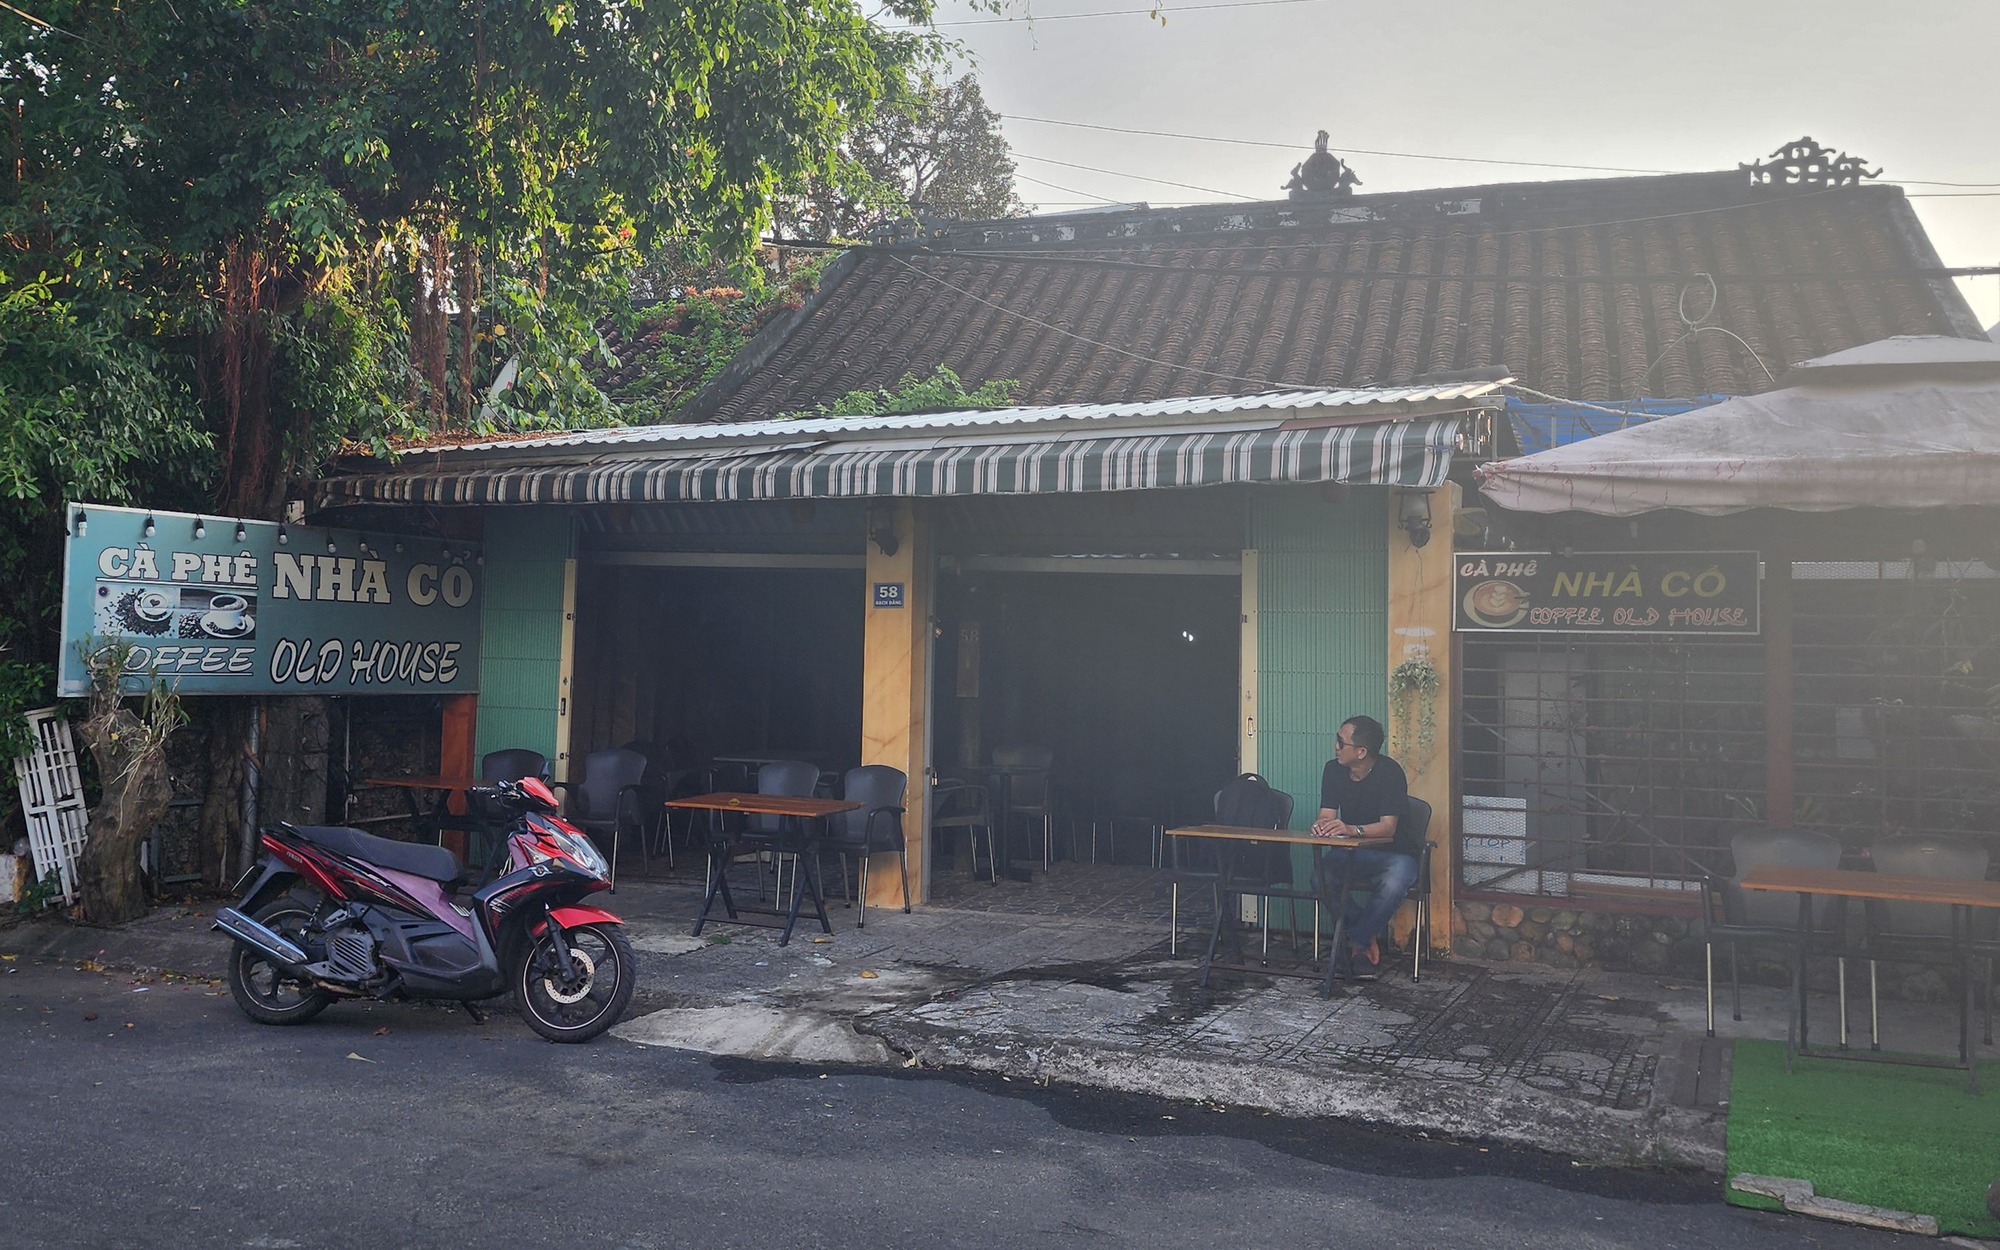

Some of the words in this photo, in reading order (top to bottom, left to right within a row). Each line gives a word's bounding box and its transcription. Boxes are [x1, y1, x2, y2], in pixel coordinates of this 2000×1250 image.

[98, 542, 159, 579] CÀ
[171, 550, 258, 585] PHÊ
[272, 550, 391, 604] NHÀ
[406, 550, 474, 608] CỔ
[1460, 559, 1489, 577] CÀ
[1494, 560, 1537, 577] PHÊ
[879, 586, 898, 598] 58
[1551, 564, 1643, 597] NHÀ
[1530, 607, 1605, 625] COFFEE
[1613, 607, 1660, 626] OLD
[1668, 607, 1748, 626] HOUSE
[89, 644, 256, 672] COFFEE
[270, 638, 344, 685] OLD
[349, 639, 462, 685] HOUSE
